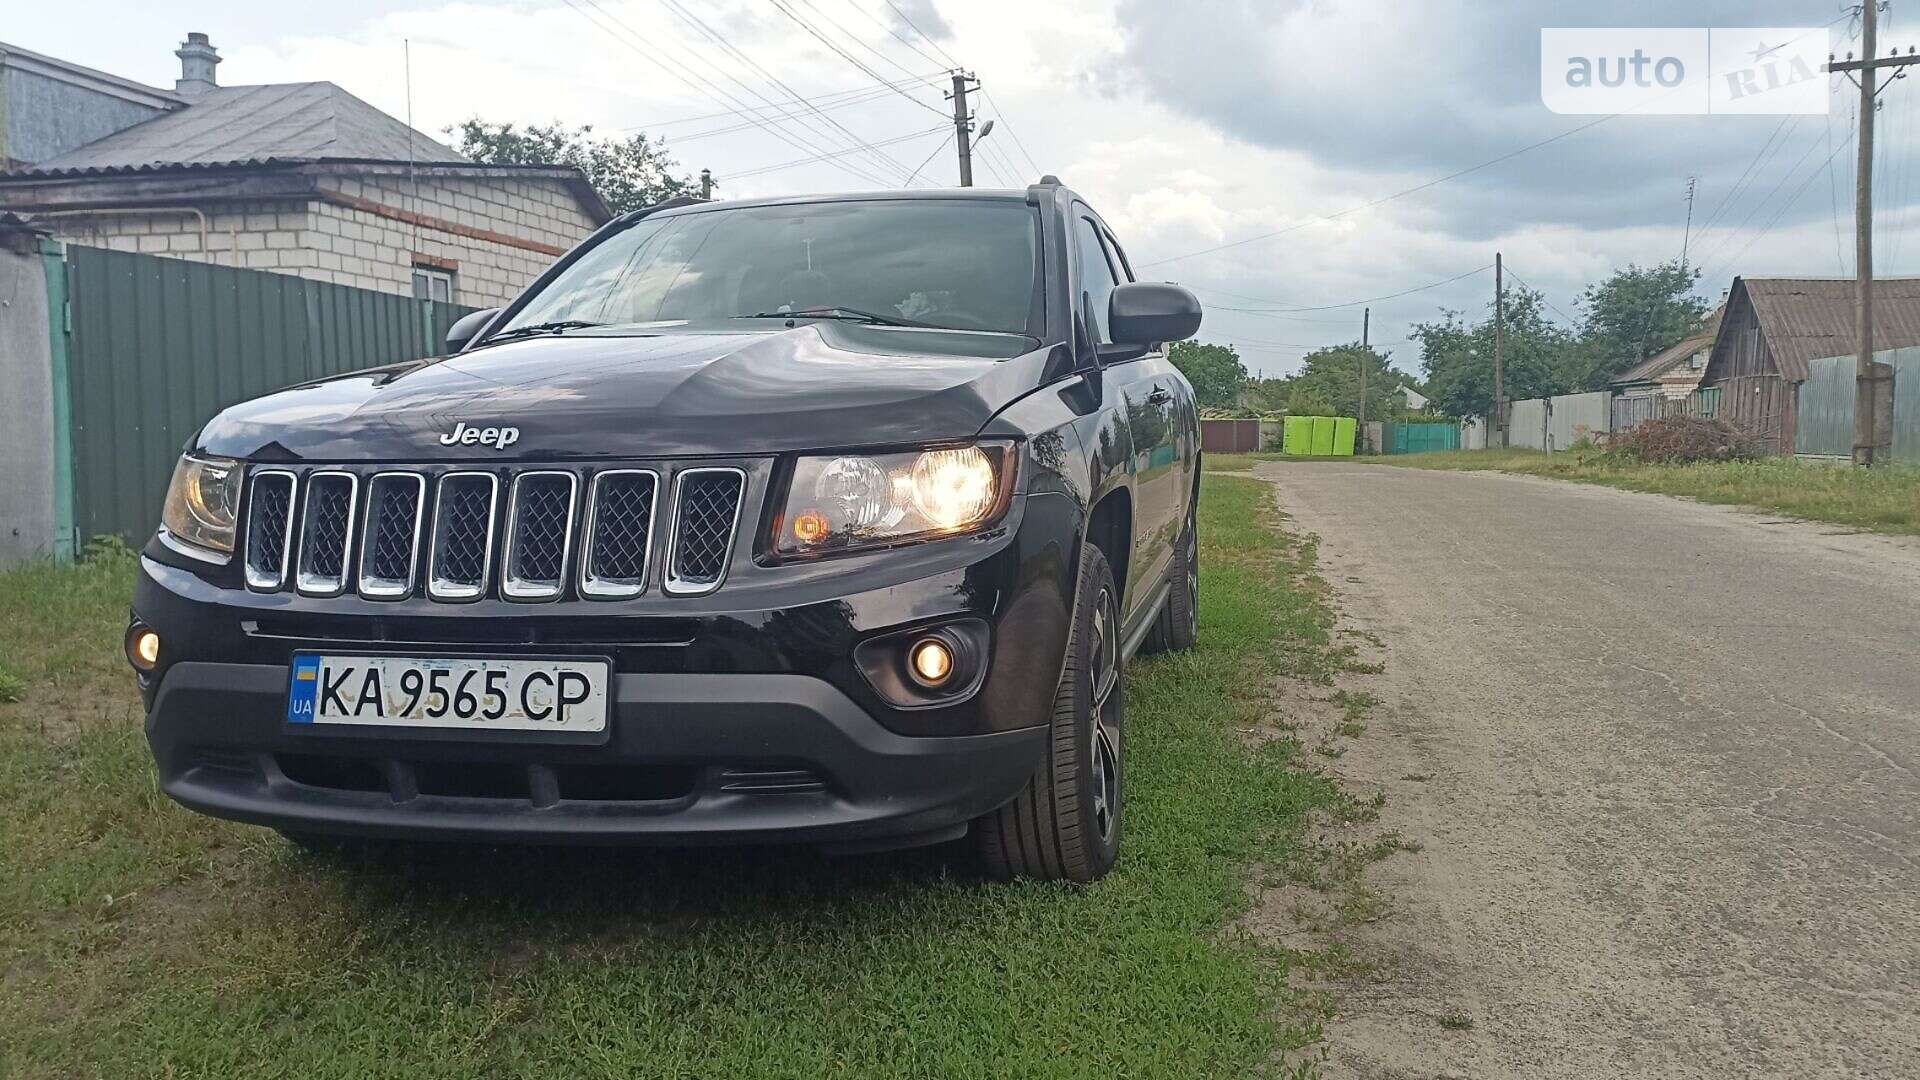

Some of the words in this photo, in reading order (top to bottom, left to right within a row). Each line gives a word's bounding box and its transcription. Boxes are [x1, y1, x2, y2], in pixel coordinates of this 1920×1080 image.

[440, 422, 520, 449] Jeep
[293, 699, 312, 715] UA
[319, 667, 385, 717] KA
[399, 669, 507, 719] 9565
[520, 671, 591, 721] CP
